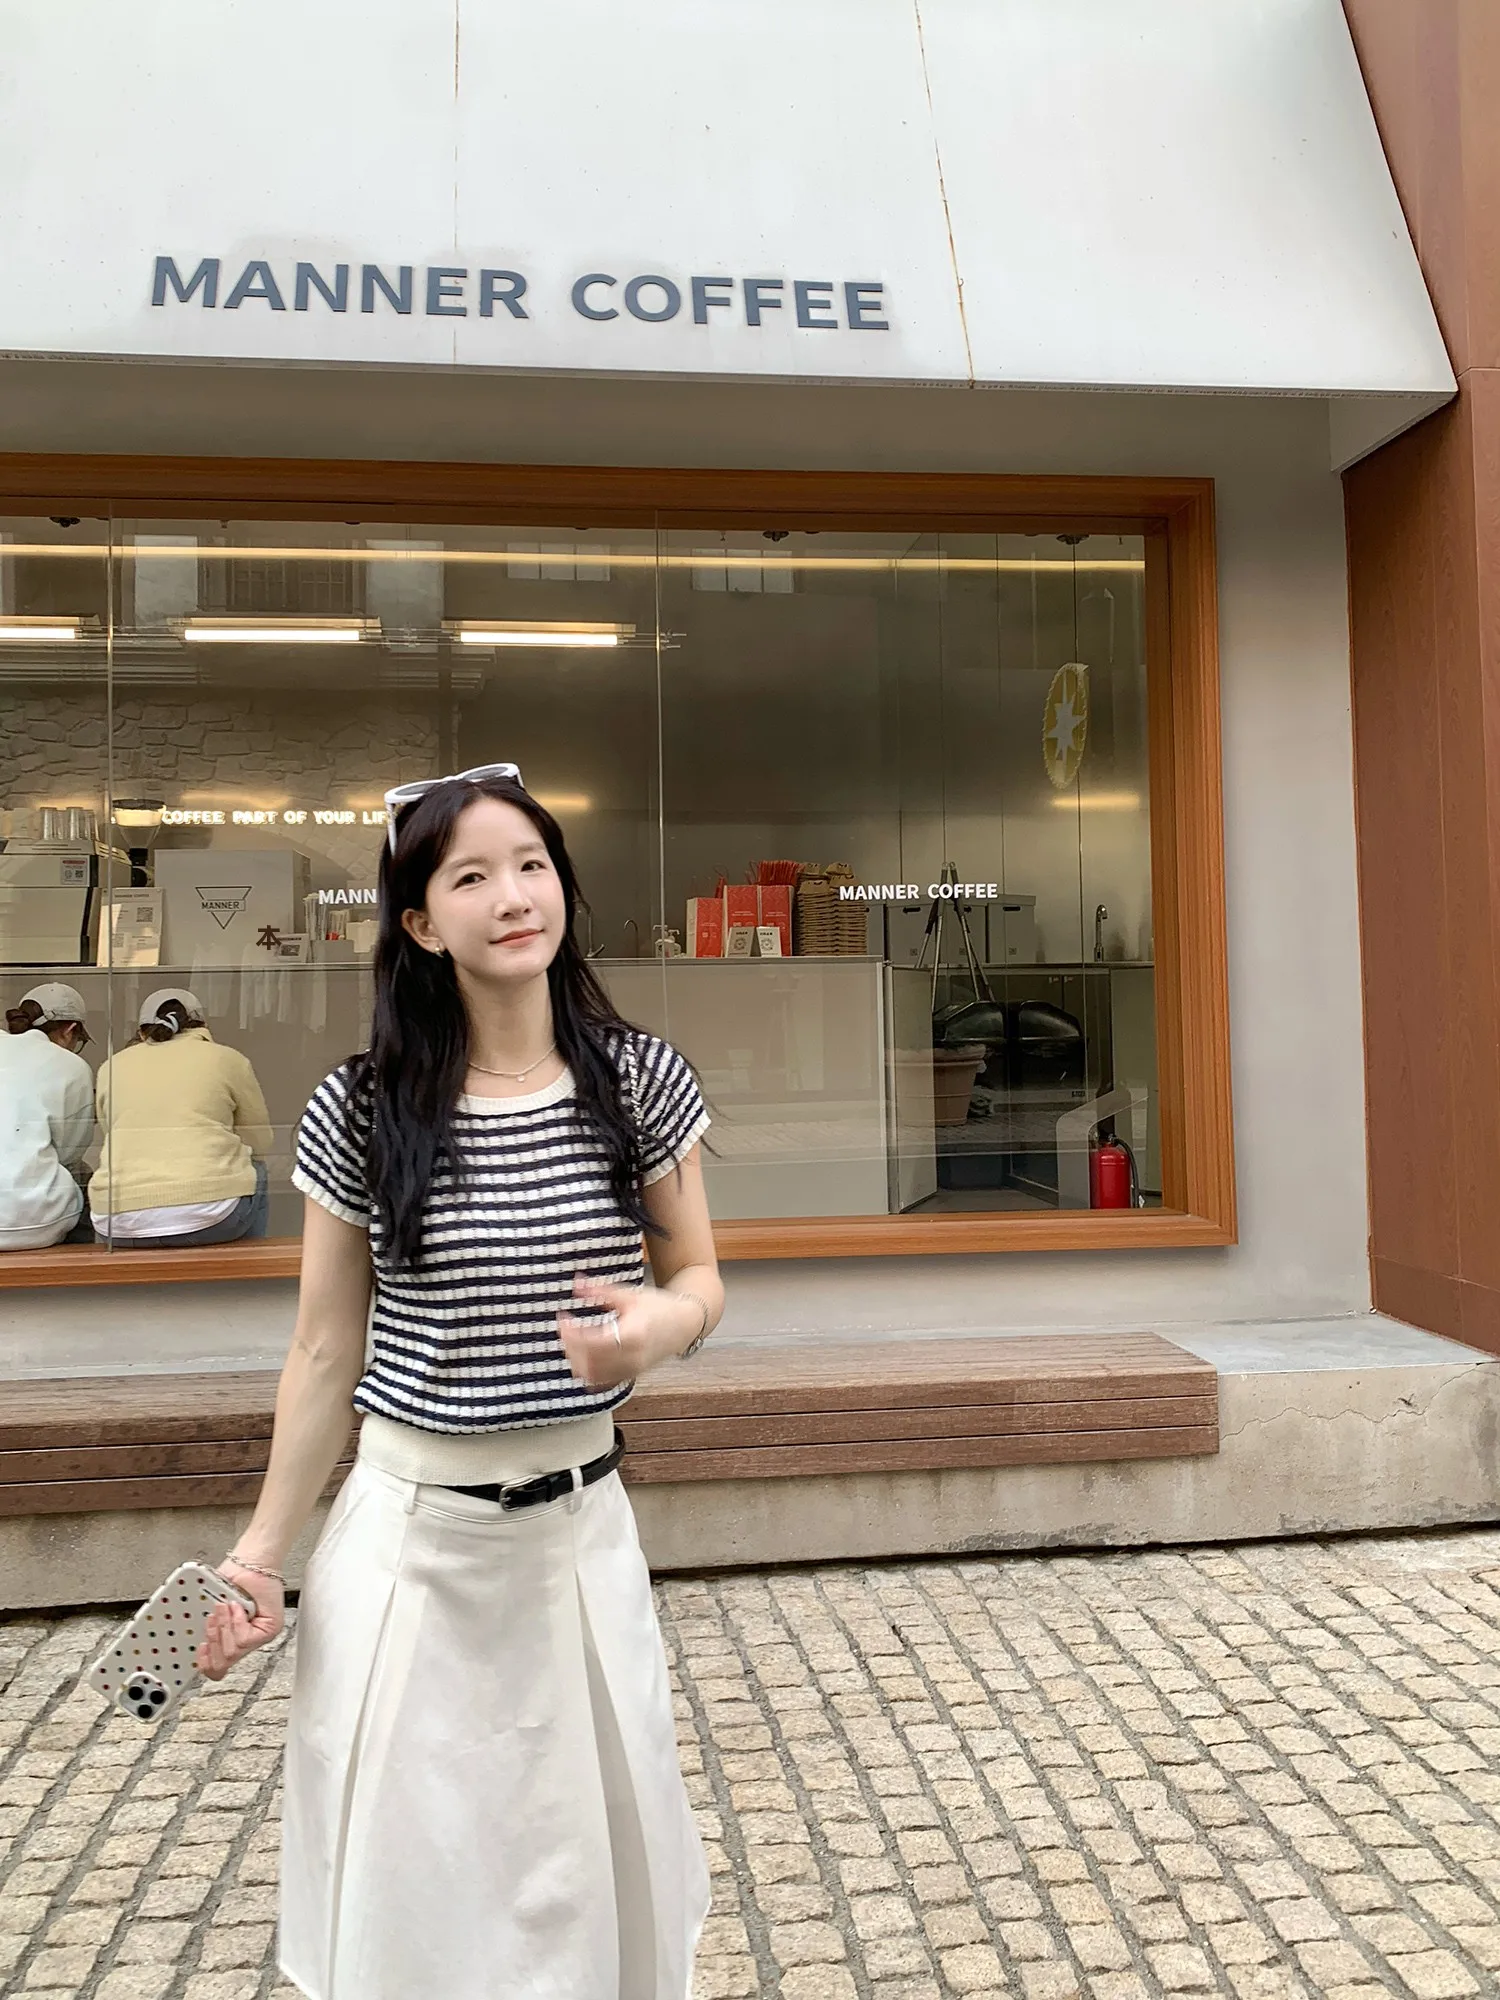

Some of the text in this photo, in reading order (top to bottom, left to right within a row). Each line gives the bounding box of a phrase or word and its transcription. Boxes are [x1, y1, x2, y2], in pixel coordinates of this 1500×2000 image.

[152, 255, 889, 330] MANNER COFFEE
[161, 810, 387, 825] COFFEE PART OF YOUR LIF
[318, 888, 377, 905] MANN
[839, 883, 998, 901] MANNER COFFEE
[201, 901, 240, 910] MANNER
[256, 925, 281, 950] 本
